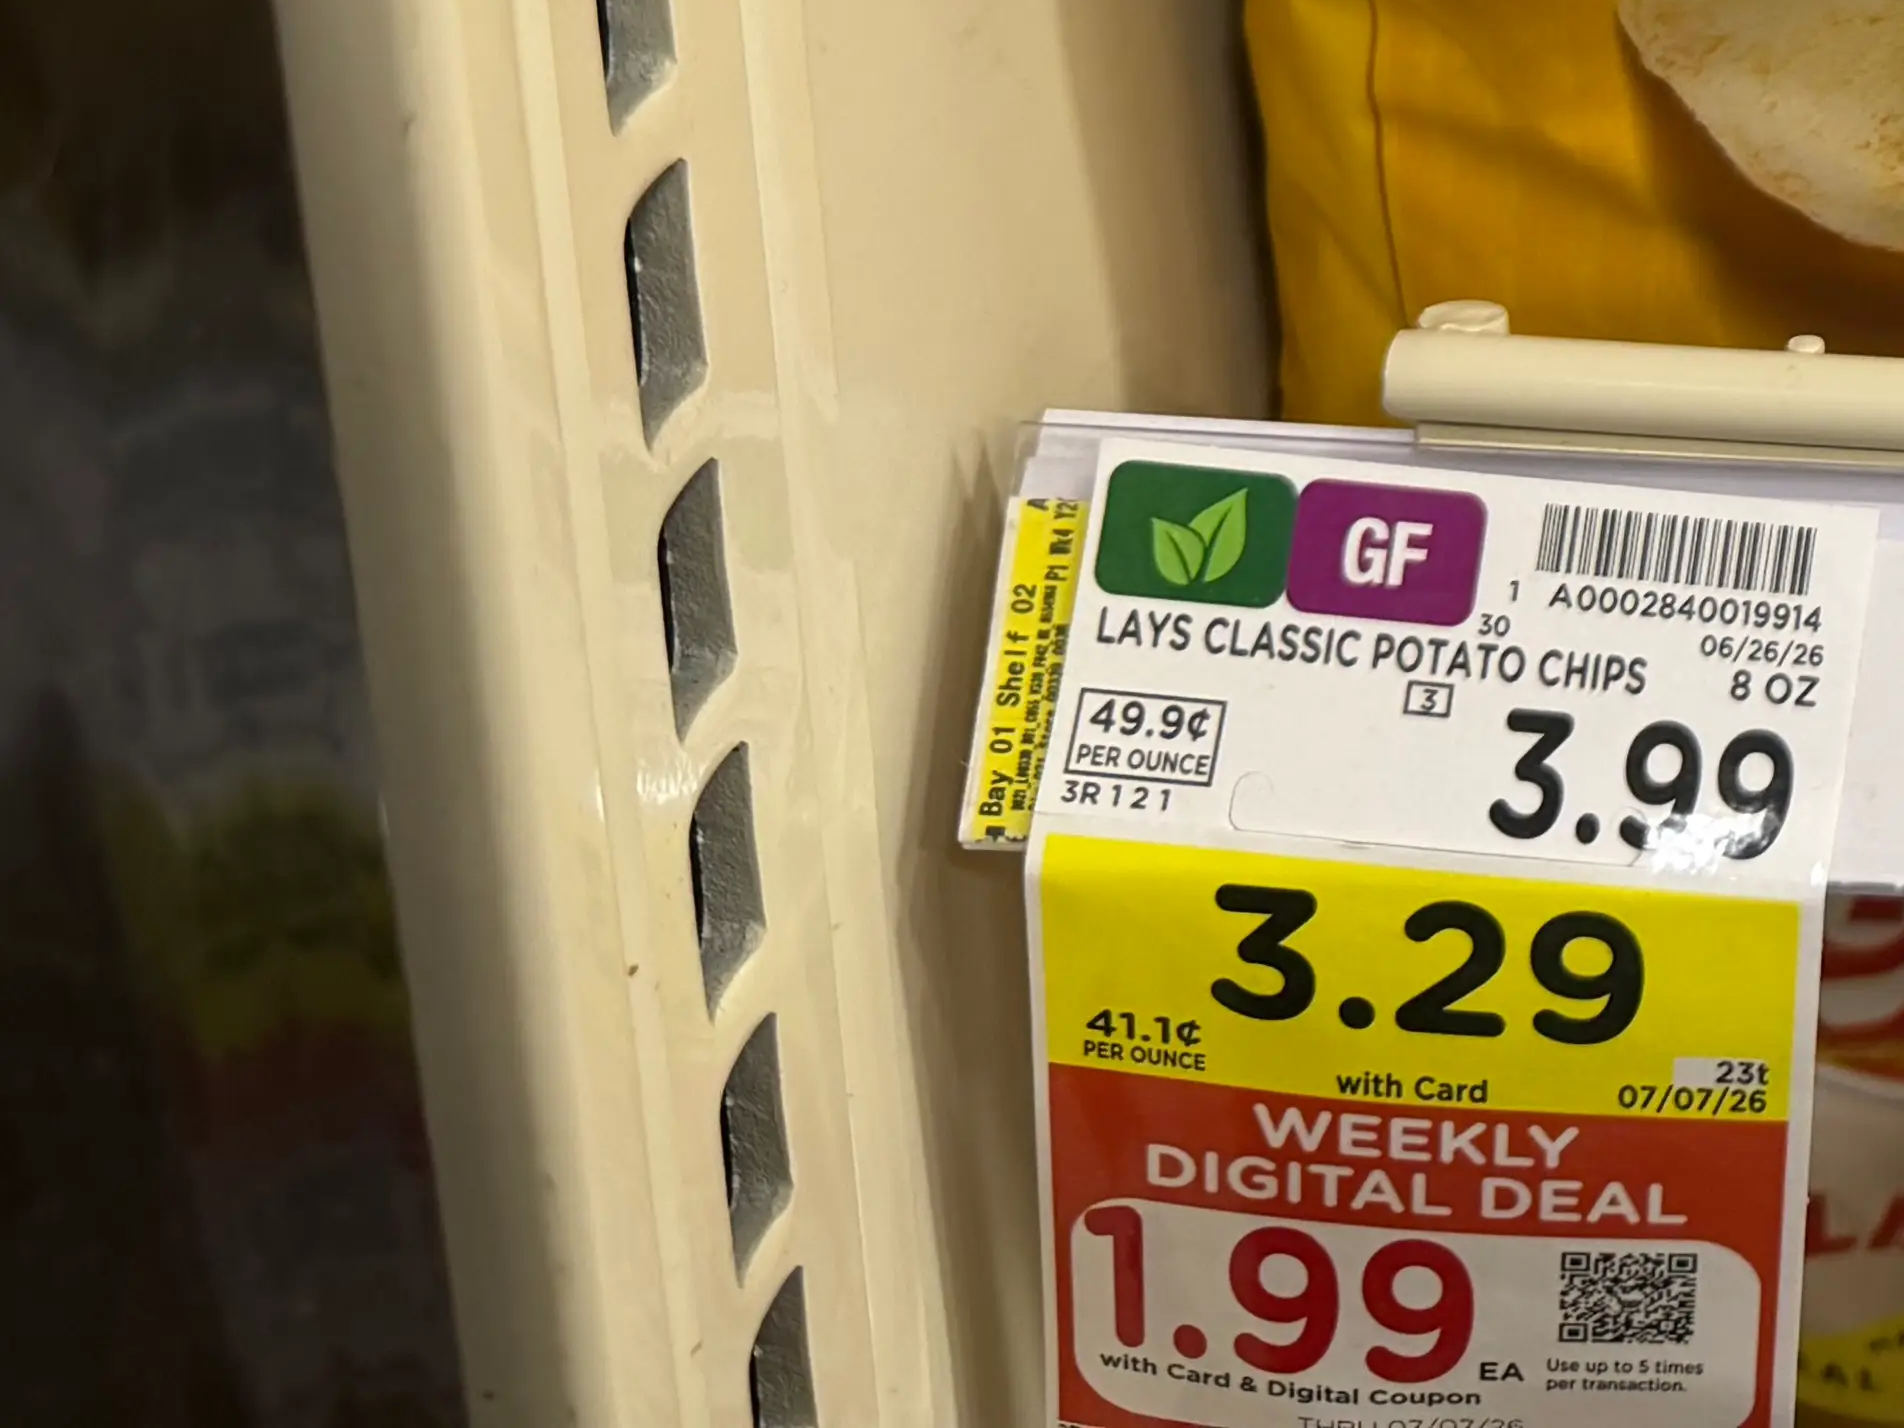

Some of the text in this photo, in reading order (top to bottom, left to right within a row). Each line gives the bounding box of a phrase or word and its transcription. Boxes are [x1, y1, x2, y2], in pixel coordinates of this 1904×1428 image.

[1340, 515, 1434, 589] GF
[1010, 583, 1038, 615] 02
[1508, 579, 1520, 603] 1
[1548, 582, 1823, 634] A0002840019914
[1477, 613, 1512, 638] 30
[995, 629, 1030, 708] Shelf
[1096, 606, 1194, 652] LAYS
[1203, 616, 1363, 668] CLASSIC
[1371, 632, 1527, 683] POTATO
[1538, 649, 1648, 695] CHIPS
[1700, 634, 1825, 667] 06/26/26
[1419, 688, 1439, 712] 3
[1729, 671, 1820, 708] 8 OZ
[1089, 697, 1212, 742] 49.9¢
[988, 726, 1017, 755] 01
[1076, 743, 1211, 777] PER OUNCE
[978, 769, 1014, 817] Bay
[1060, 779, 1172, 812] 3R 1 2 1
[1488, 707, 1795, 861] 3.99
[1209, 881, 1646, 1046] 3.29
[1085, 1008, 1203, 1048] 41.1¢
[1083, 1039, 1208, 1072] PER OUNCE
[1336, 1070, 1489, 1106] with Card
[1617, 1084, 1769, 1116] 07/07/26
[1253, 1102, 1580, 1170] WEEKLY
[1146, 1143, 1689, 1227] DIGITAL DEAL
[1084, 1204, 1476, 1384] 1.99
[1098, 1351, 1482, 1410] with Card & Digital Coupon
[1478, 1360, 1526, 1383] EA
[1546, 1357, 1704, 1376] Use up to 5 times
[1545, 1377, 1689, 1393] per transaction.
